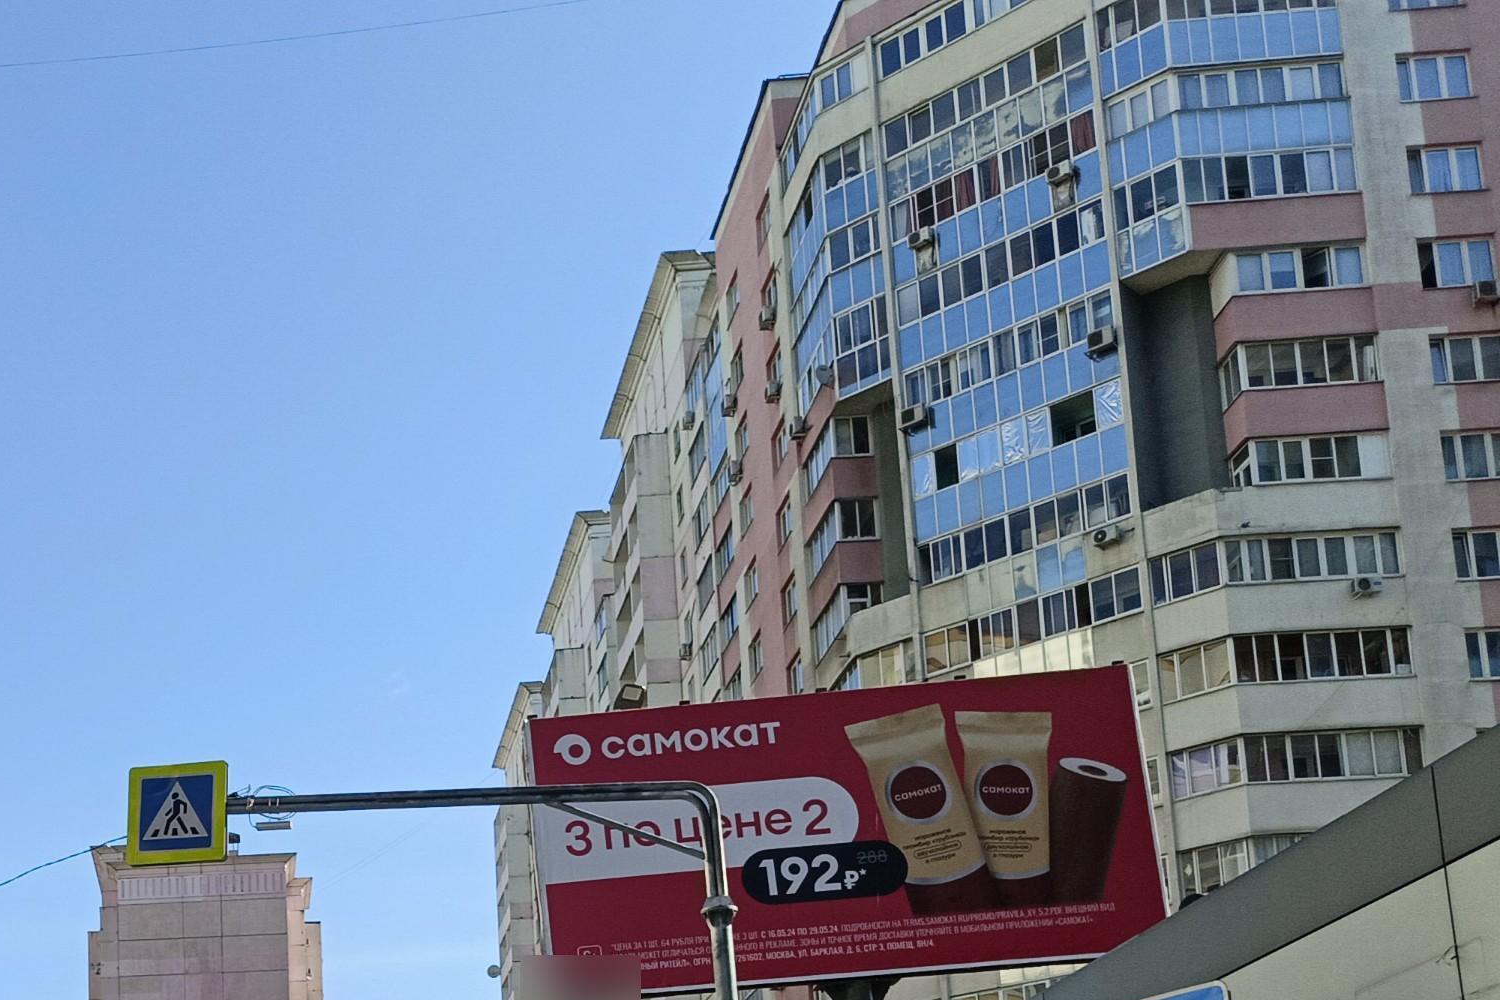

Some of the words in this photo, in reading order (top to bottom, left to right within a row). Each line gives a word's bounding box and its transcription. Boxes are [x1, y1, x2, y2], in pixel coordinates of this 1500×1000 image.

[601, 721, 781, 760] самокат
[894, 783, 943, 802] самокат
[981, 786, 1031, 795] самокат
[565, 820, 593, 857] 3
[604, 816, 661, 850] по
[802, 799, 832, 836] 2
[797, 927, 807, 936] ПО
